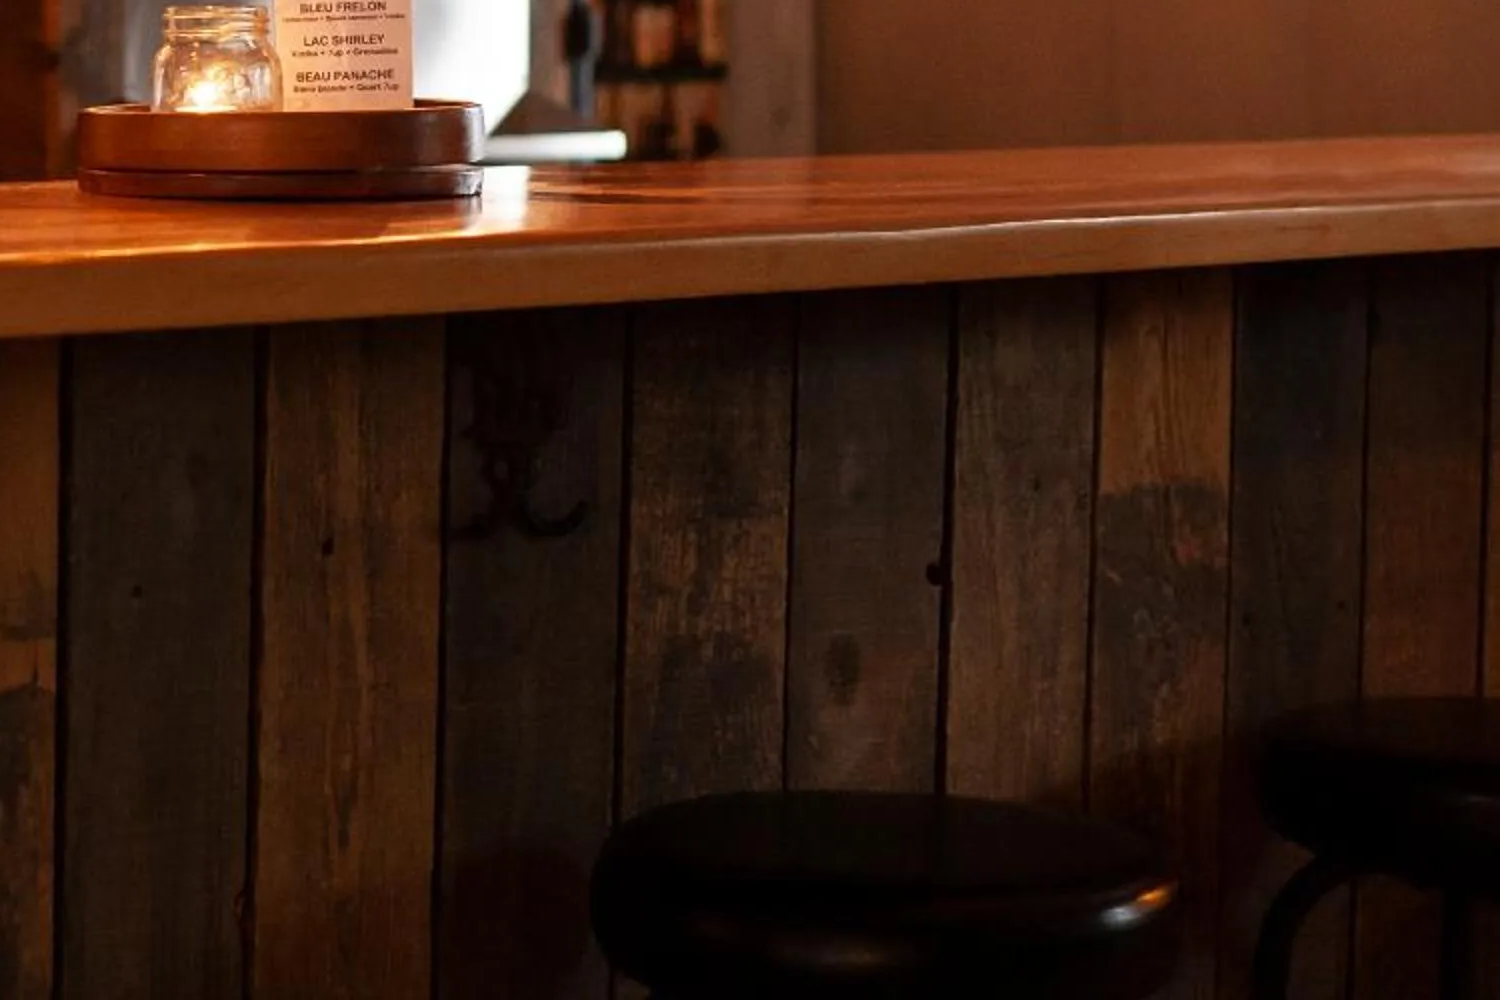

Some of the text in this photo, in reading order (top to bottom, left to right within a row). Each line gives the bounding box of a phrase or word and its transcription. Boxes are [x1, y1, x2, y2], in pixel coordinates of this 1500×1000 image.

[300, 1, 387, 13] BLEU FRELON
[303, 34, 385, 47] LAC SHIRLEY
[296, 71, 331, 83] BEAU
